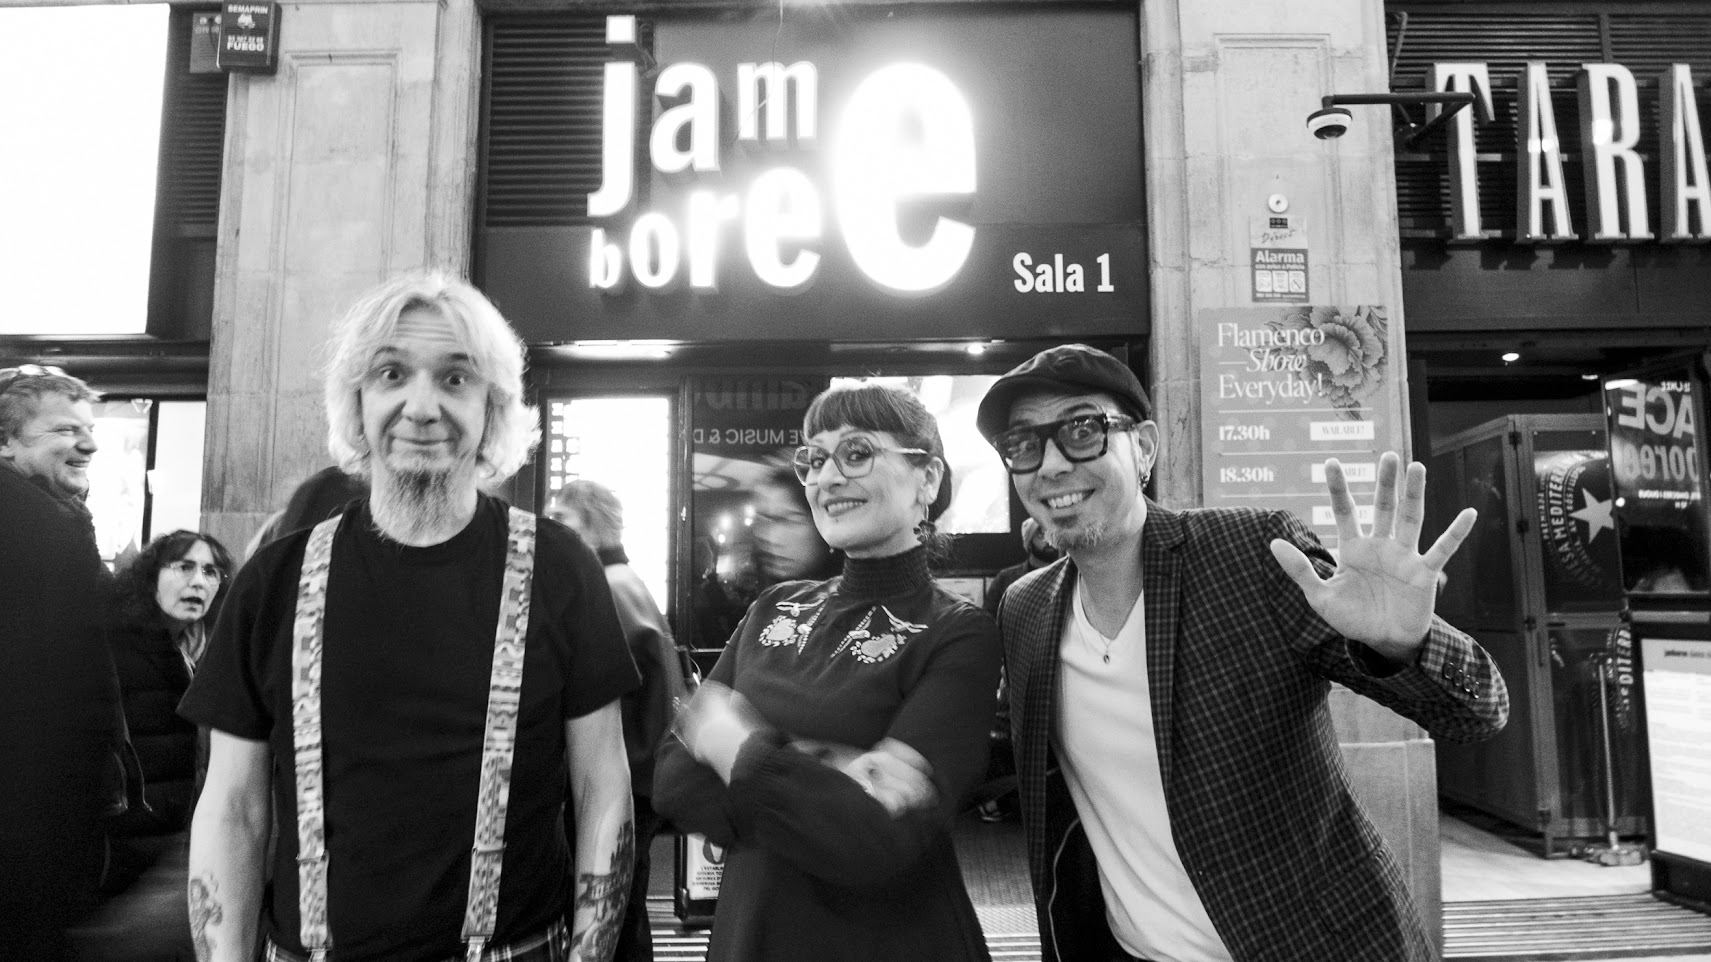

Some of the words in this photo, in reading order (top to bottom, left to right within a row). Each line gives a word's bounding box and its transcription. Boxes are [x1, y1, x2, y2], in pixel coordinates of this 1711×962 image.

[227, 42, 265, 51] FUEGO
[1255, 249, 1305, 263] Alarma
[1013, 251, 1085, 293] Sala
[1096, 252, 1115, 292] 1
[1217, 322, 1325, 347] Flamenco
[1247, 348, 1307, 372] Show
[1219, 373, 1322, 404] Everyday!
[1218, 425, 1271, 441] 17.30h
[1220, 466, 1274, 483] 18.30h
